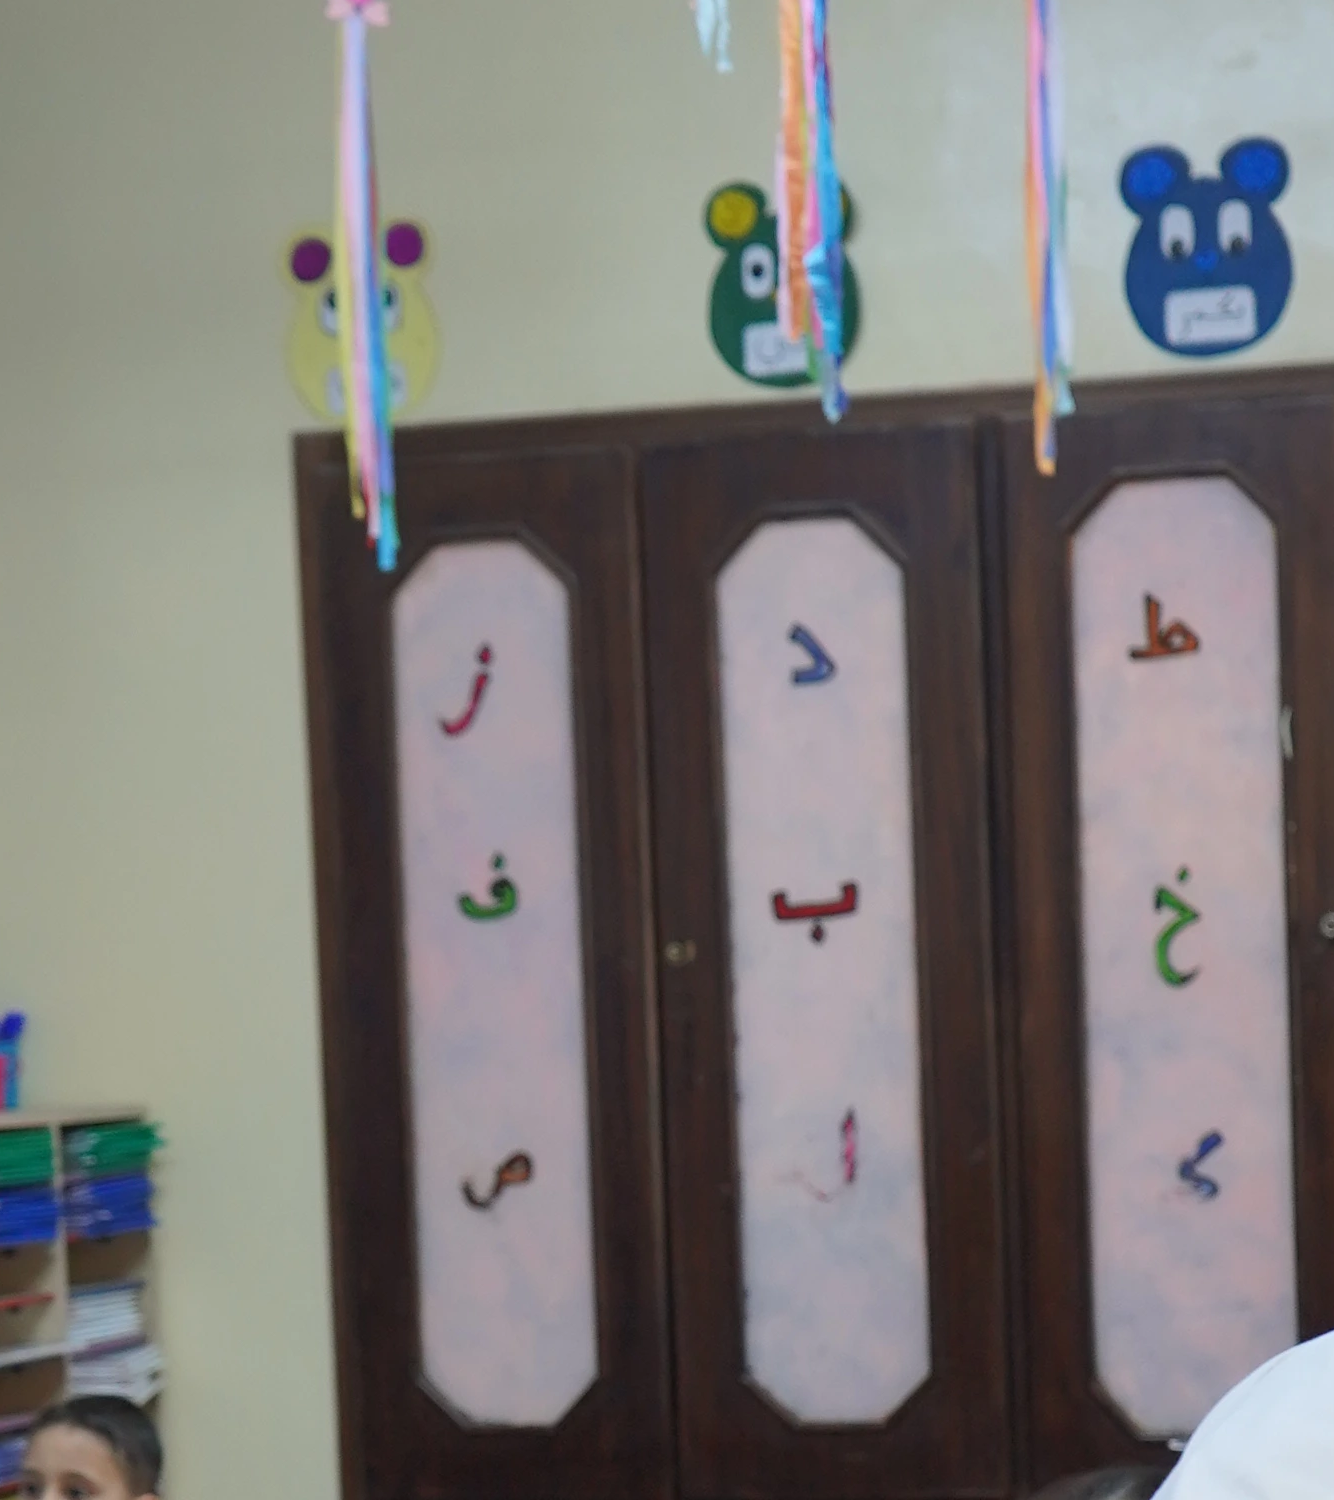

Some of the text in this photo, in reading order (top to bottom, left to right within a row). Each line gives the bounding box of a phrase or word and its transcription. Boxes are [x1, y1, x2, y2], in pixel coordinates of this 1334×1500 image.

[788, 624, 836, 687] د
[1128, 592, 1201, 662] ط
[439, 643, 493, 738] ز
[457, 854, 519, 923] ف
[770, 881, 860, 944] ب
[1153, 867, 1200, 989] خ
